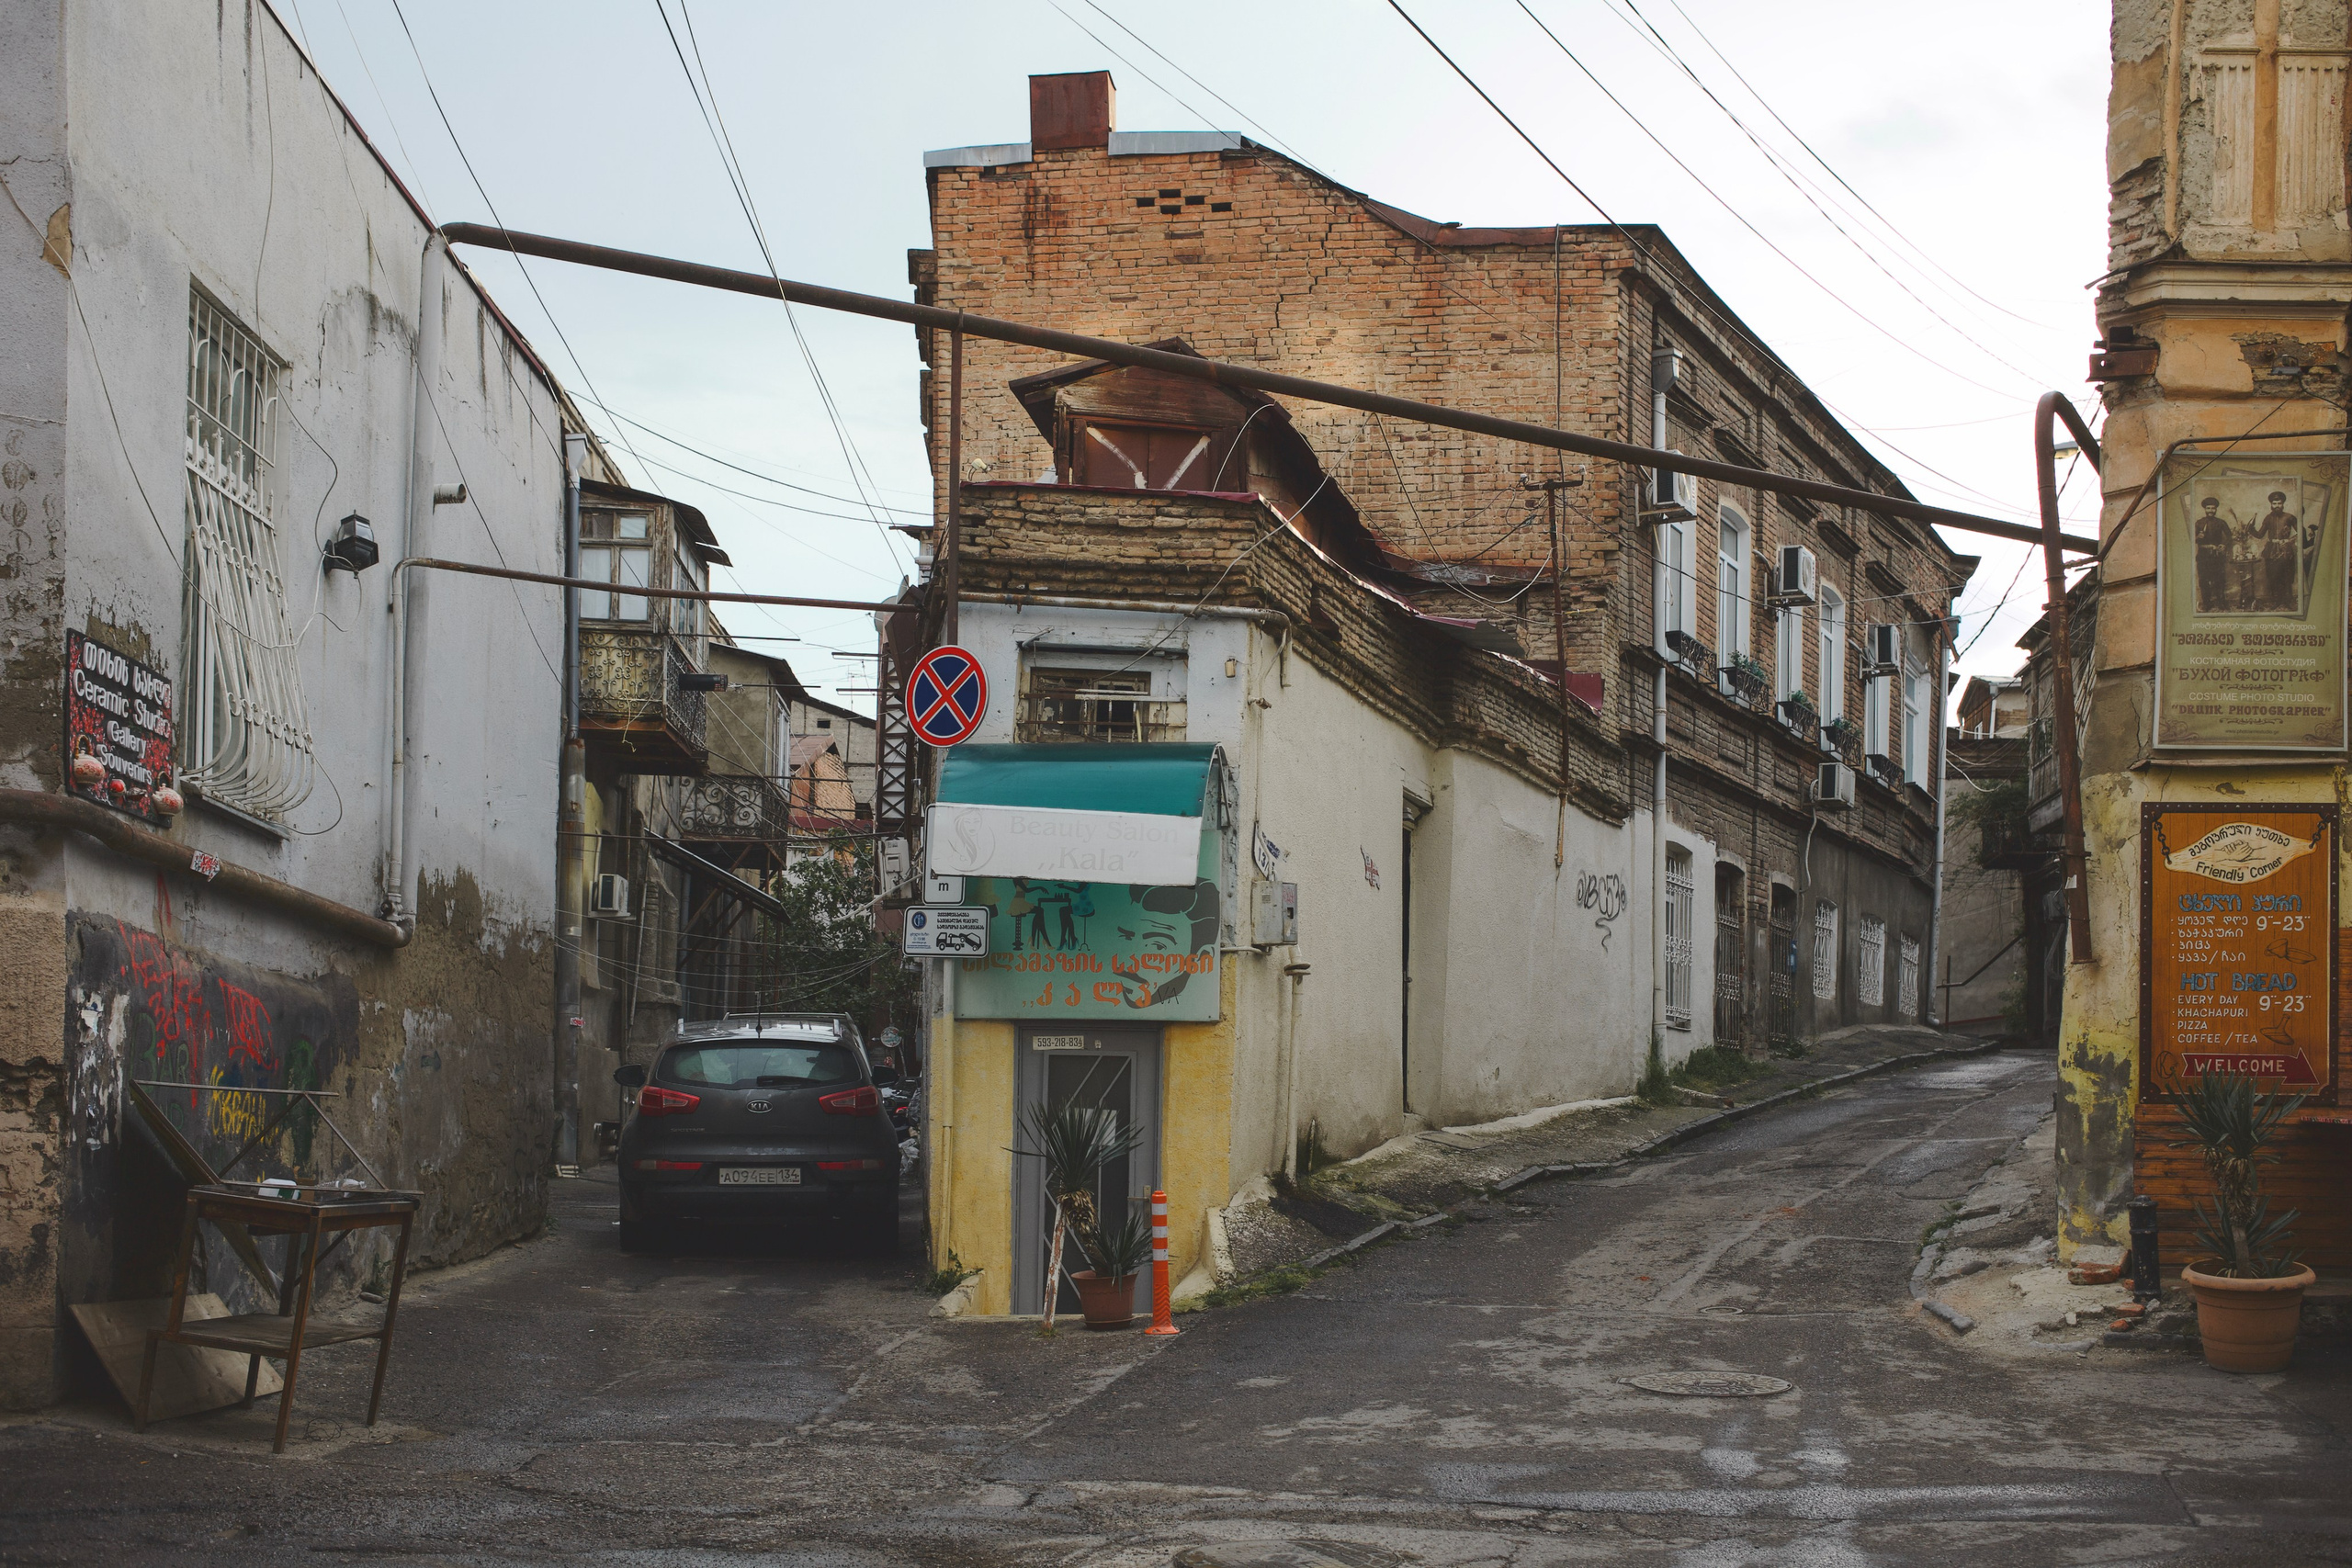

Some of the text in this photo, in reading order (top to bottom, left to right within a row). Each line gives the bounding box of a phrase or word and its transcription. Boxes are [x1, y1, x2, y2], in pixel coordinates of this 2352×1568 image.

[2189, 657, 2316, 667] КОСТЮМНАЯ ФОТОСТУДИЯ
[2188, 692, 2315, 702] COSTUME PHOTO STUDIO
[74, 669, 172, 738] Ceramic Studio
[107, 720, 146, 759] Gallery
[96, 744, 153, 785] Souvenirs
[1010, 816, 1179, 843] Beauty Salon
[2196, 856, 2282, 882] Friendly Corner
[938, 882, 949, 892] m
[2178, 893, 2302, 912] ცხელი პური
[2177, 915, 2249, 926] ყოველ დღე
[2177, 928, 2244, 938] ხაჭაპური
[2179, 940, 2211, 950] პიცა
[1111, 953, 1214, 975] სალონი
[2180, 972, 2298, 992] HOT BREAD
[2177, 995, 2239, 1005] EVERY DAY
[2177, 1008, 2249, 1018] KHACHAPURI
[2177, 1021, 2208, 1030] PIZZA
[2177, 1033, 2222, 1043] COFFEE
[2194, 1058, 2286, 1073] WELCOME
[778, 1168, 798, 1179] 134
